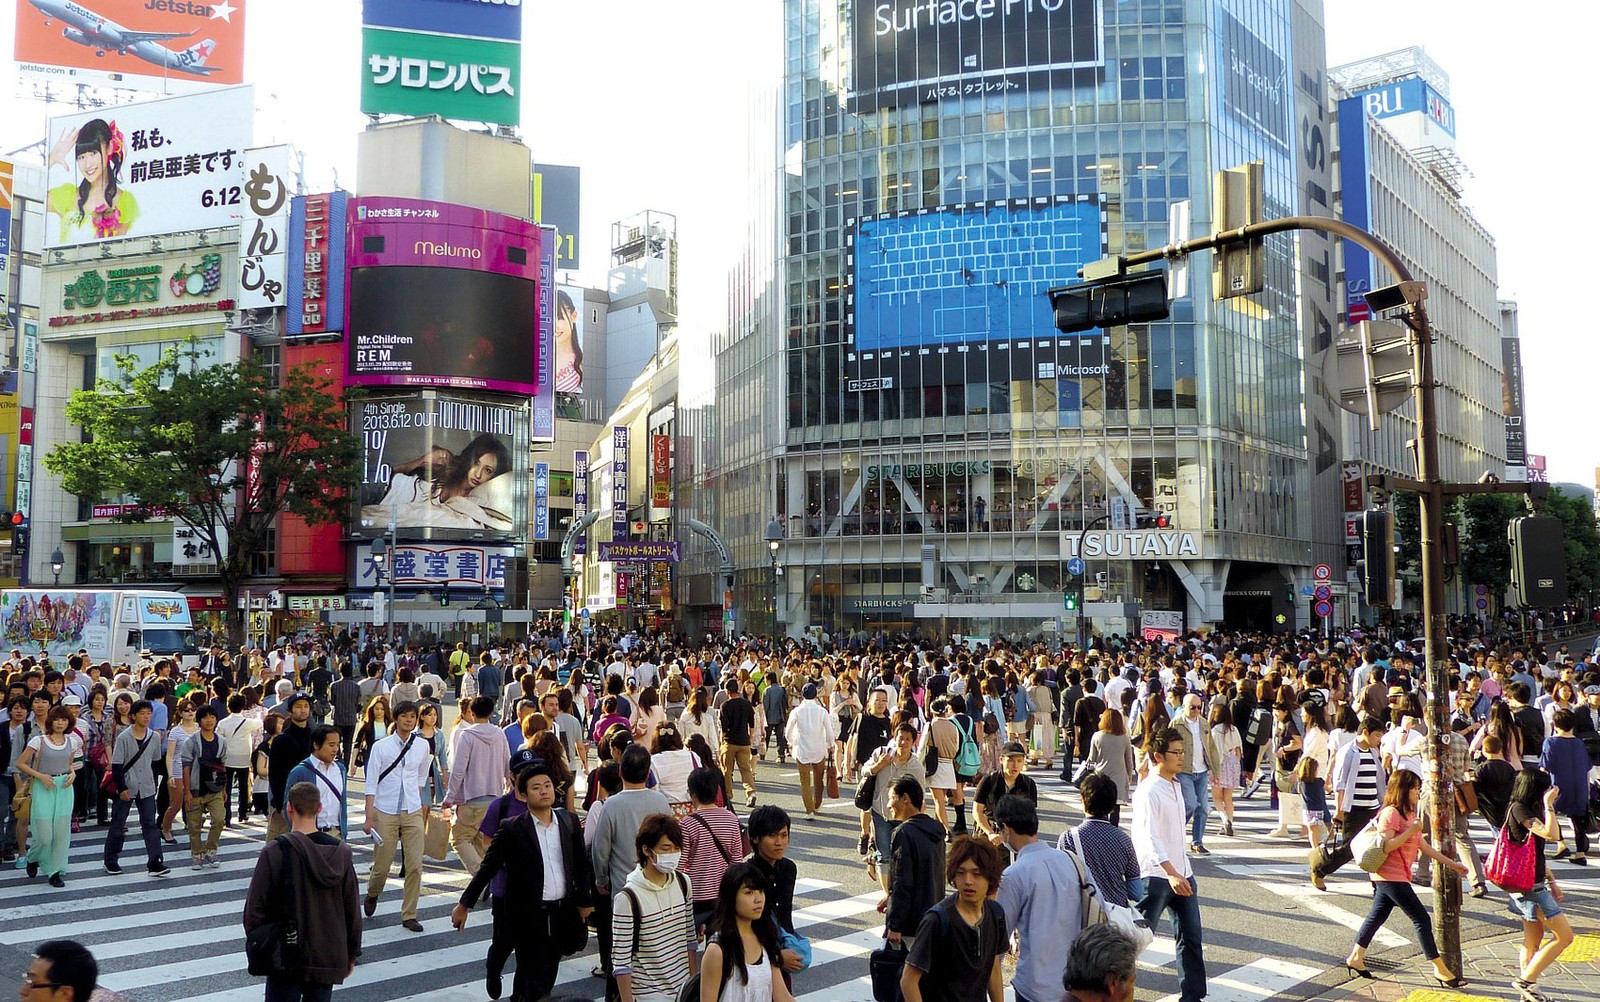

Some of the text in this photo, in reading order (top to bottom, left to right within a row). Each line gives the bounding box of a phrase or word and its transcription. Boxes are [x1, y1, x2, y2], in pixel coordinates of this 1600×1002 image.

[65, 2, 99, 24] Jetstar
[144, 0, 212, 18] Jetstar
[876, 0, 994, 37] Surface
[19, 63, 65, 76] jetstar.com
[368, 53, 515, 97] サロンパス
[1366, 86, 1403, 116] BU
[130, 127, 173, 152] 私も、
[200, 185, 241, 208] 6.12
[367, 208, 440, 219] わかさ生活 チャンネル
[241, 162, 286, 303] もんじゃ
[301, 198, 324, 326] 三千里薬品
[106, 276, 161, 306] 西村
[357, 334, 413, 345] Mr.Children
[1057, 363, 1110, 376] Microsoft
[851, 381, 878, 389] サーフェス
[364, 402, 406, 415] 4th Single
[363, 412, 438, 430] 2013.6.12 OUT
[613, 430, 627, 503] 洋服の青山
[866, 454, 1091, 481] STARBUCKS COFFEE
[609, 544, 671, 556] バスケットボールストリート
[1065, 533, 1198, 556] TSUTAYA
[363, 552, 504, 580] 大盛堂書店
[854, 600, 902, 608] STARBUCKS
